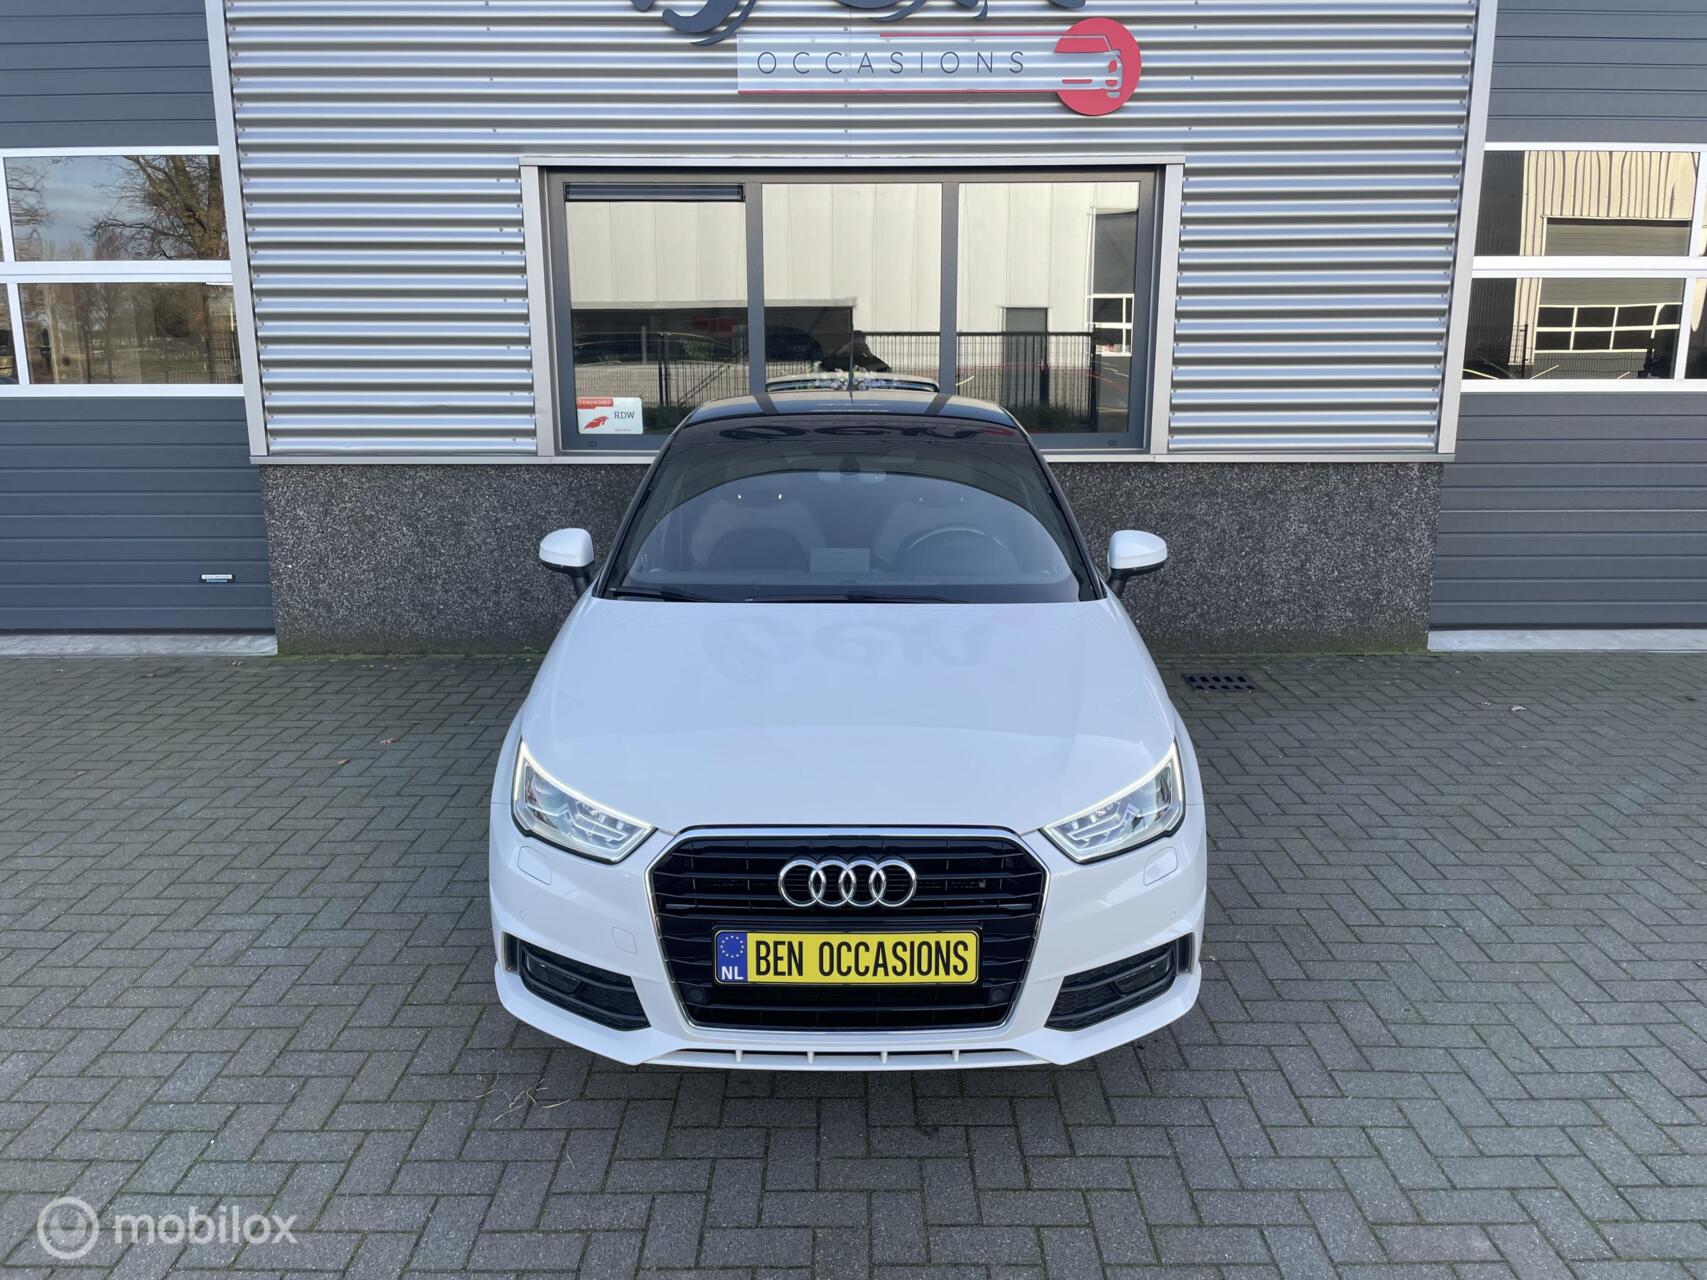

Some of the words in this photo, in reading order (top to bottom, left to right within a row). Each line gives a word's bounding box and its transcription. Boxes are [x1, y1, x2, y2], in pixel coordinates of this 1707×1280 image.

[757, 51, 1025, 75] OCCASIONS
[614, 411, 635, 419] RDW
[755, 940, 804, 976] BEN
[818, 940, 969, 977] OCCASIONS
[721, 966, 743, 980] NL
